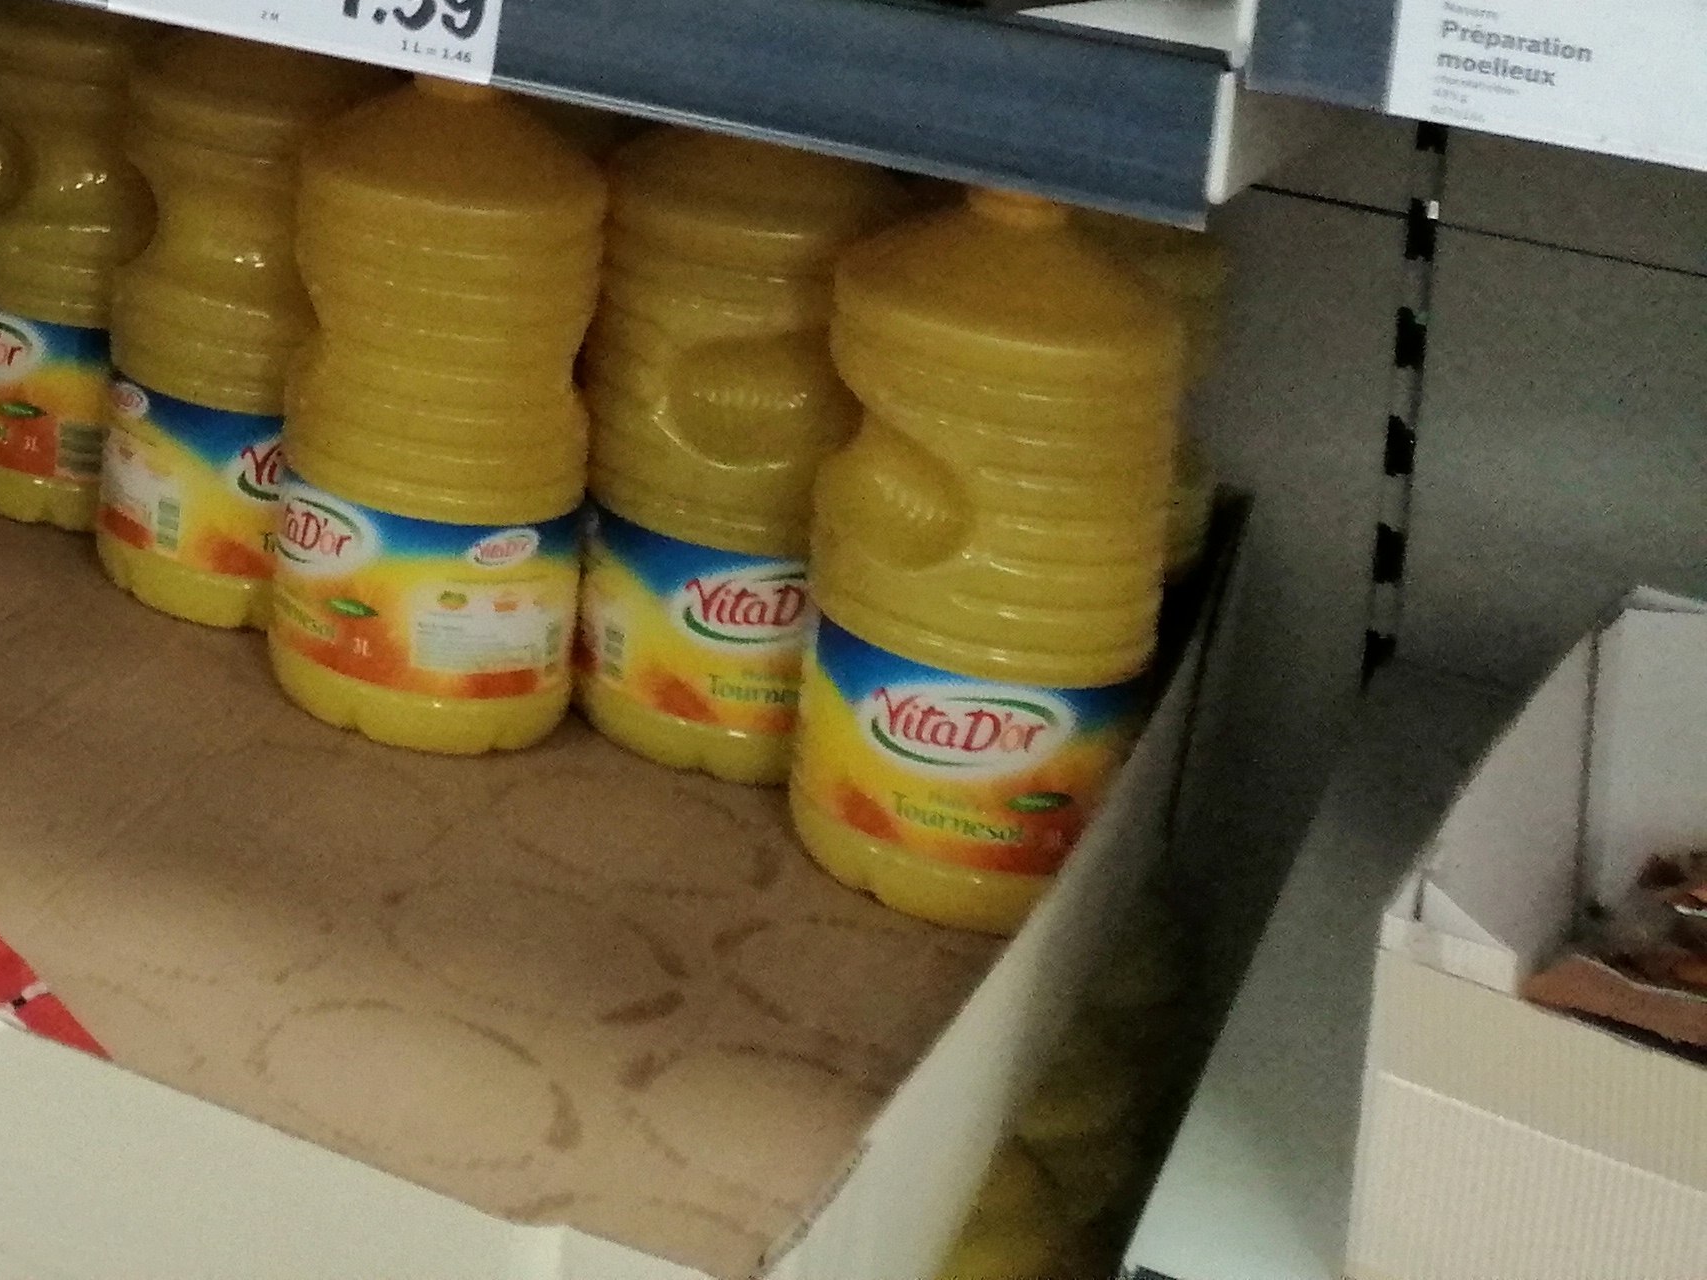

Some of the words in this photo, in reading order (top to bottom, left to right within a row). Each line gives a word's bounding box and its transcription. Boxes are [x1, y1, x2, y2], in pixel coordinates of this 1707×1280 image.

[401, 40, 407, 51] 1
[412, 42, 422, 54] L
[442, 47, 473, 63] 1.46
[1441, 19, 1593, 63] Préparation
[1437, 52, 1556, 87] moelleux
